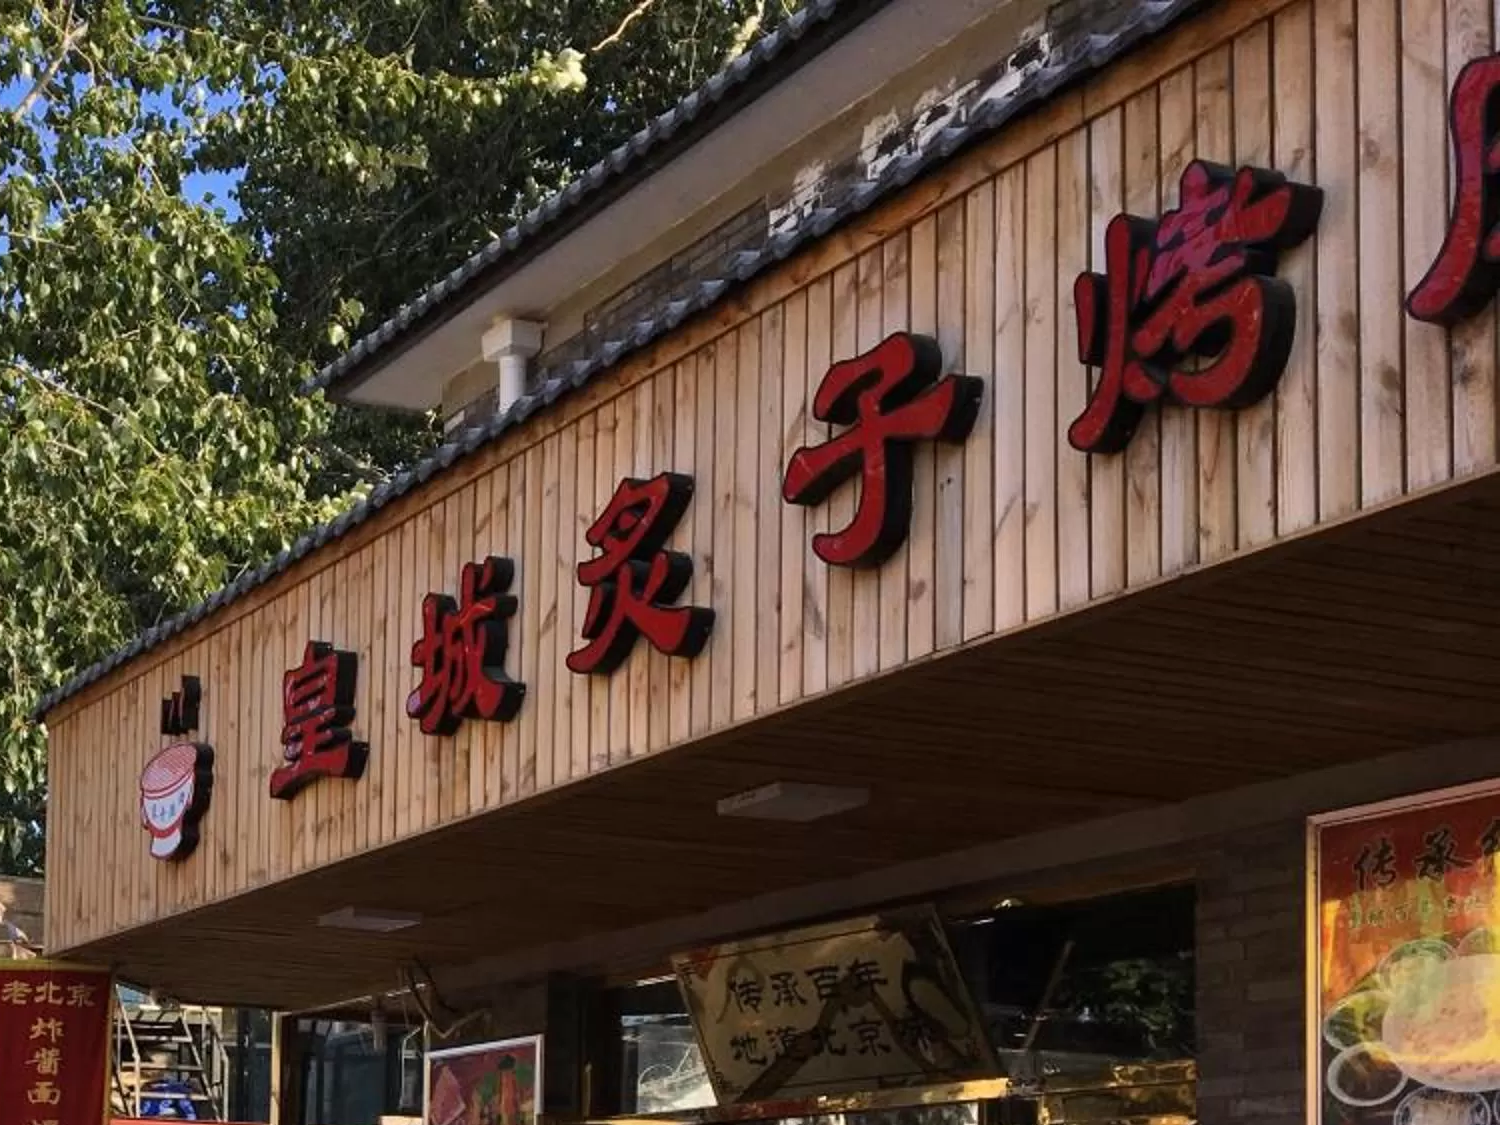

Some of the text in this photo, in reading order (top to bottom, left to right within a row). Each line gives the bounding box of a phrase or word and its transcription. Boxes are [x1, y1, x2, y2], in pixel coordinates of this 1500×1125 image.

[2, 979, 97, 1007] 老北京
[729, 957, 888, 1013] 传承百年
